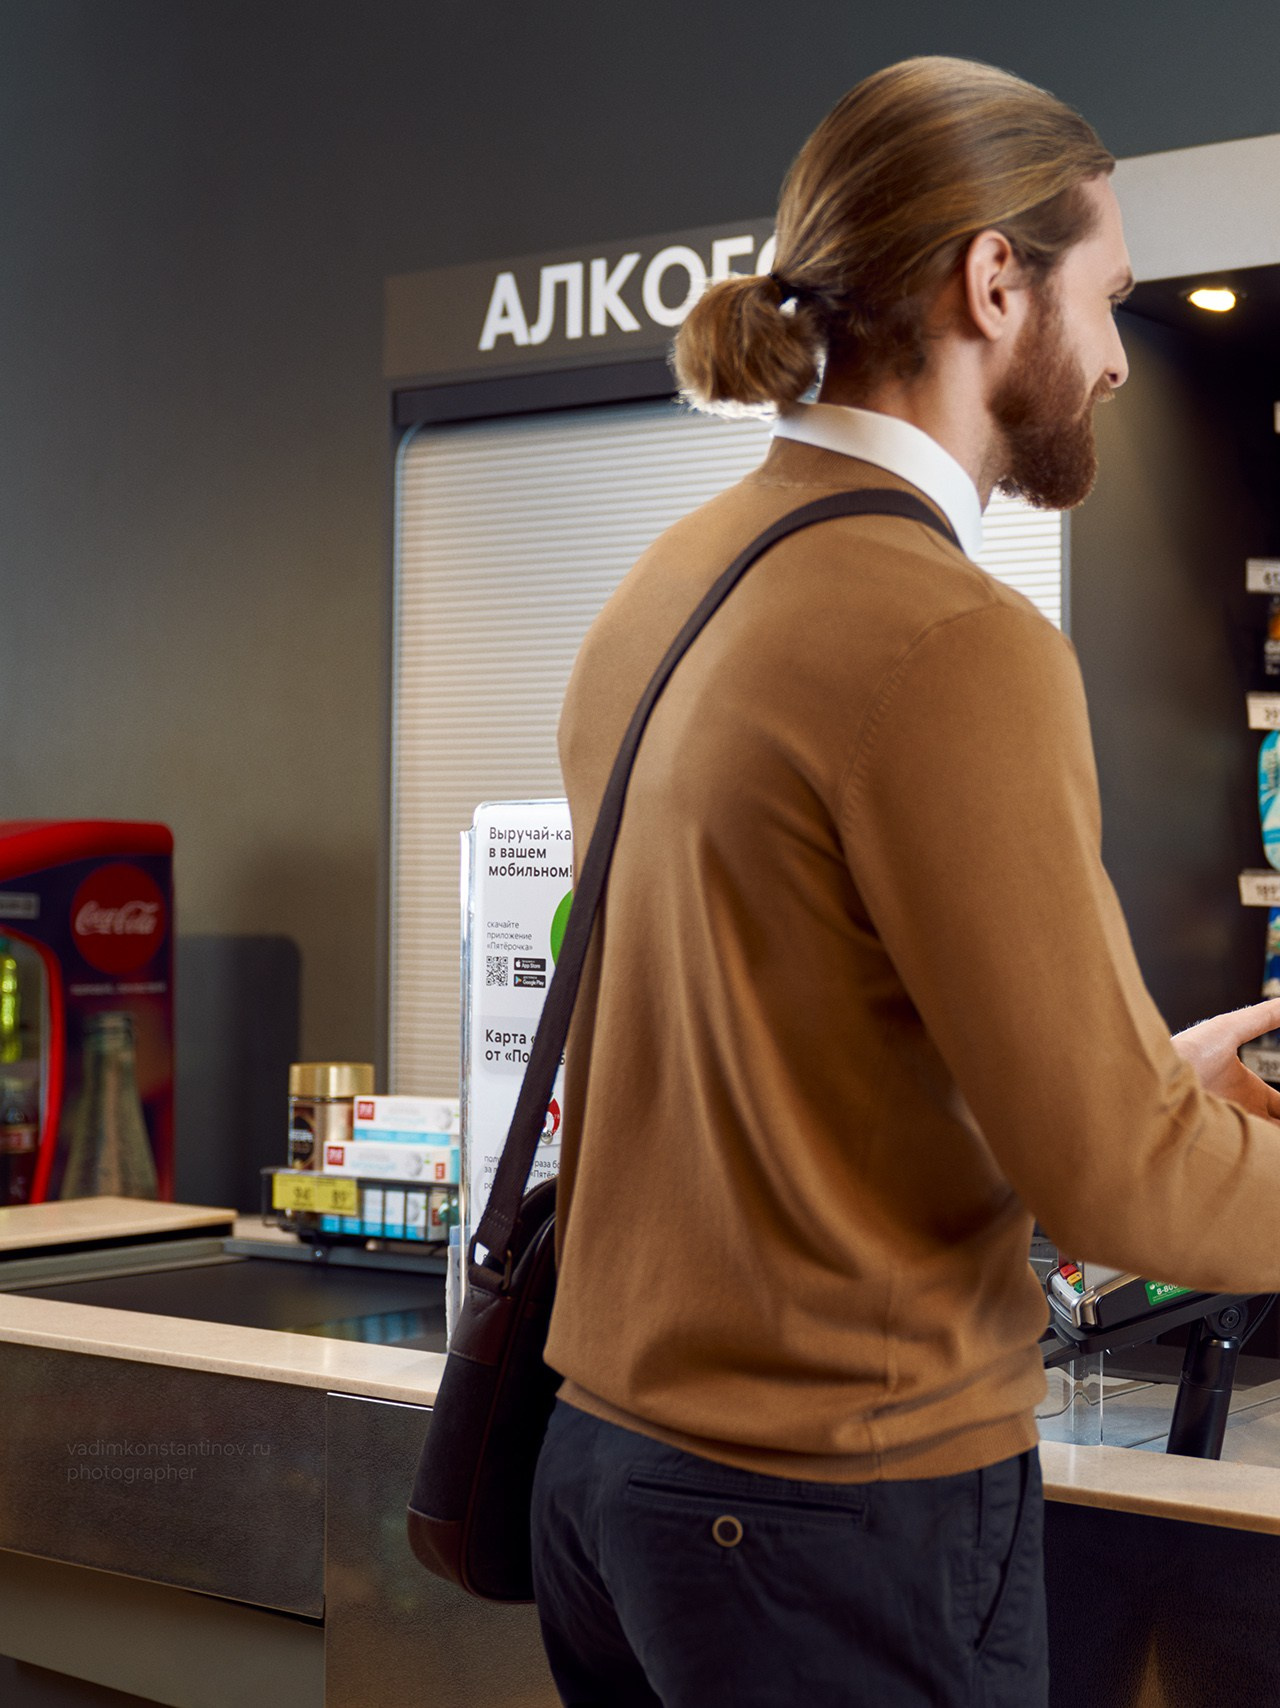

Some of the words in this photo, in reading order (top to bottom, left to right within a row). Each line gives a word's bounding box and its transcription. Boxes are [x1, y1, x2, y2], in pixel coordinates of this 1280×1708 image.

[489, 847, 496, 858] в
[500, 847, 547, 859] вашем
[487, 920, 519, 931] скачайте
[487, 932, 532, 942] приложение
[486, 1029, 526, 1046] Карта
[485, 1050, 501, 1061] от
